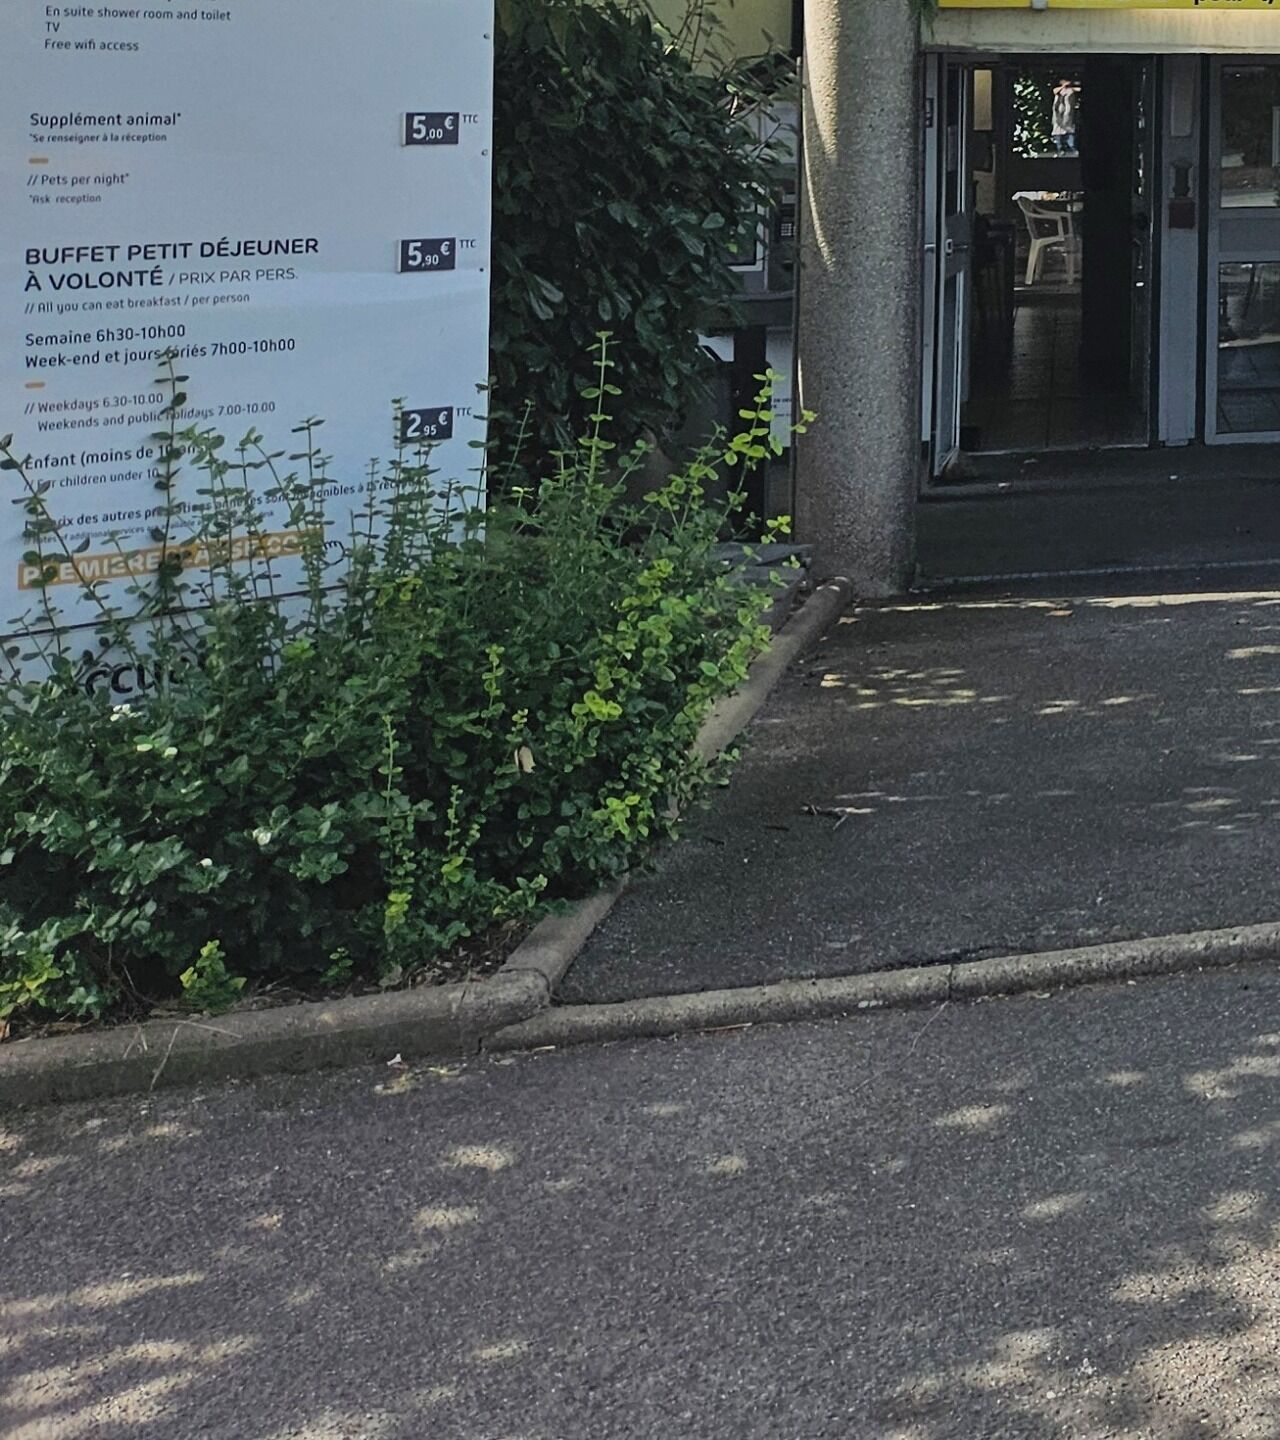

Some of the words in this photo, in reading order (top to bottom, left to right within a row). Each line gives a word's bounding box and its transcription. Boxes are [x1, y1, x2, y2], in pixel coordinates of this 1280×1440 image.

[46, 6, 60, 16] En
[63, 6, 94, 17] suite
[97, 7, 140, 18] shower
[143, 11, 173, 19] room
[176, 10, 197, 20] and
[201, 11, 231, 21] toilet
[45, 22, 60, 32] TV
[44, 39, 71, 50] Free
[74, 39, 96, 50] wifi
[99, 42, 139, 51] access
[30, 112, 122, 129] Supplément
[48, 134, 99, 144] renseigner
[121, 132, 167, 143] réception
[41, 174, 68, 185] Pets
[71, 176, 91, 187] per
[55, 194, 102, 204] reception
[25, 245, 120, 265] BUFFET
[127, 242, 193, 260] PETIT
[200, 236, 319, 258] DÉJEUNER
[24, 270, 42, 292] À
[49, 265, 164, 290] VOLONTÉ
[179, 272, 215, 285] PRIX
[220, 270, 251, 282] PAR
[255, 268, 298, 280] PERS.
[38, 302, 53, 313] All
[56, 303, 79, 315] you
[82, 299, 102, 310] can
[105, 299, 124, 310] eat
[127, 295, 181, 309] breakfast
[192, 295, 209, 306] per
[213, 293, 250, 305] person
[25, 330, 92, 347] Semaine
[96, 324, 186, 342] 6h30-10h00
[25, 351, 100, 369] Week-end
[105, 351, 120, 363] et
[124, 348, 161, 365] jours
[211, 338, 295, 357] 7h00-10h00
[38, 399, 99, 413] Weekdays
[38, 417, 99, 432] Weekends
[103, 415, 124, 425] and
[128, 412, 163, 426] public
[25, 454, 76, 470] Enfant
[136, 446, 153, 459] de
[59, 474, 107, 488] children
[110, 470, 142, 482] under
[77, 512, 98, 525] des
[102, 509, 141, 523] autres
